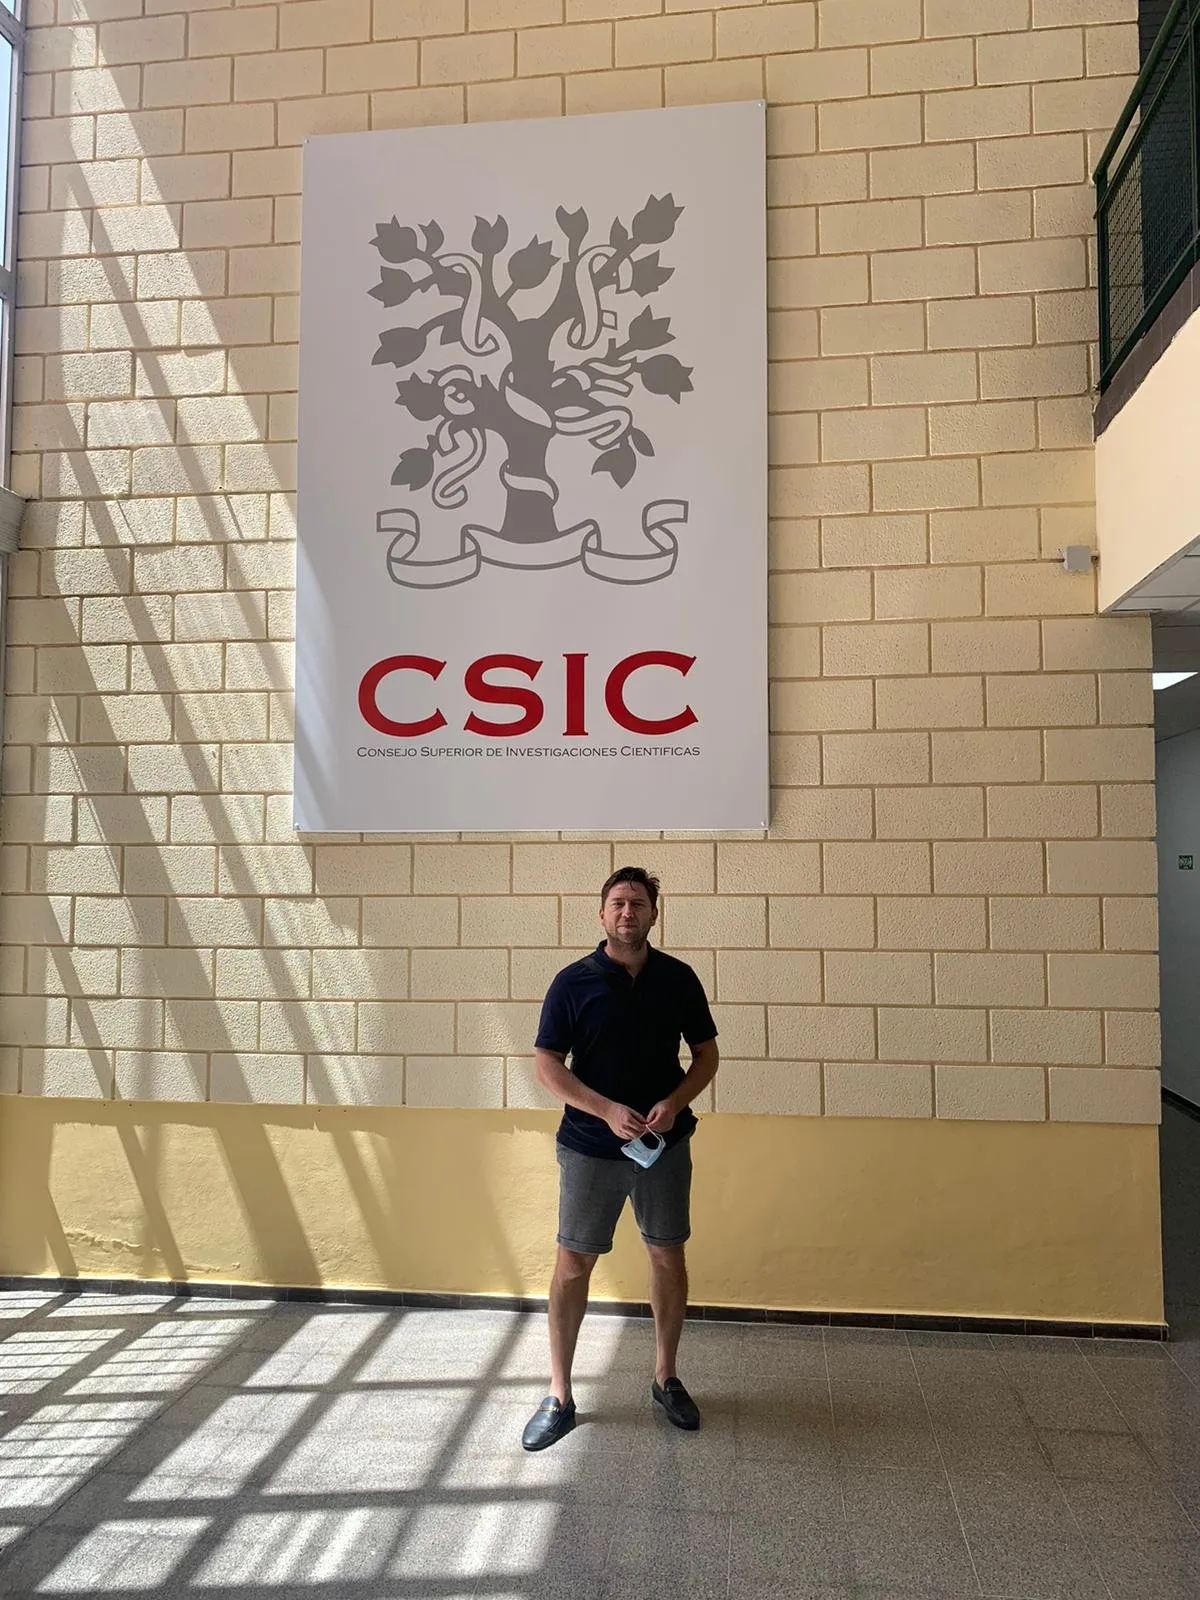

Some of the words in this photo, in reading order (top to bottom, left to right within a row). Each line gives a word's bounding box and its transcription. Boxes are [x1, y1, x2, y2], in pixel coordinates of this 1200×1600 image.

[357, 650, 699, 739] CSIC
[356, 746, 418, 758] CONSEJO
[420, 746, 483, 758] SUPERIOR
[486, 747, 503, 758] DE
[506, 746, 618, 758] INVESTIGACIONES
[620, 745, 701, 757] CIENTIFICAS
